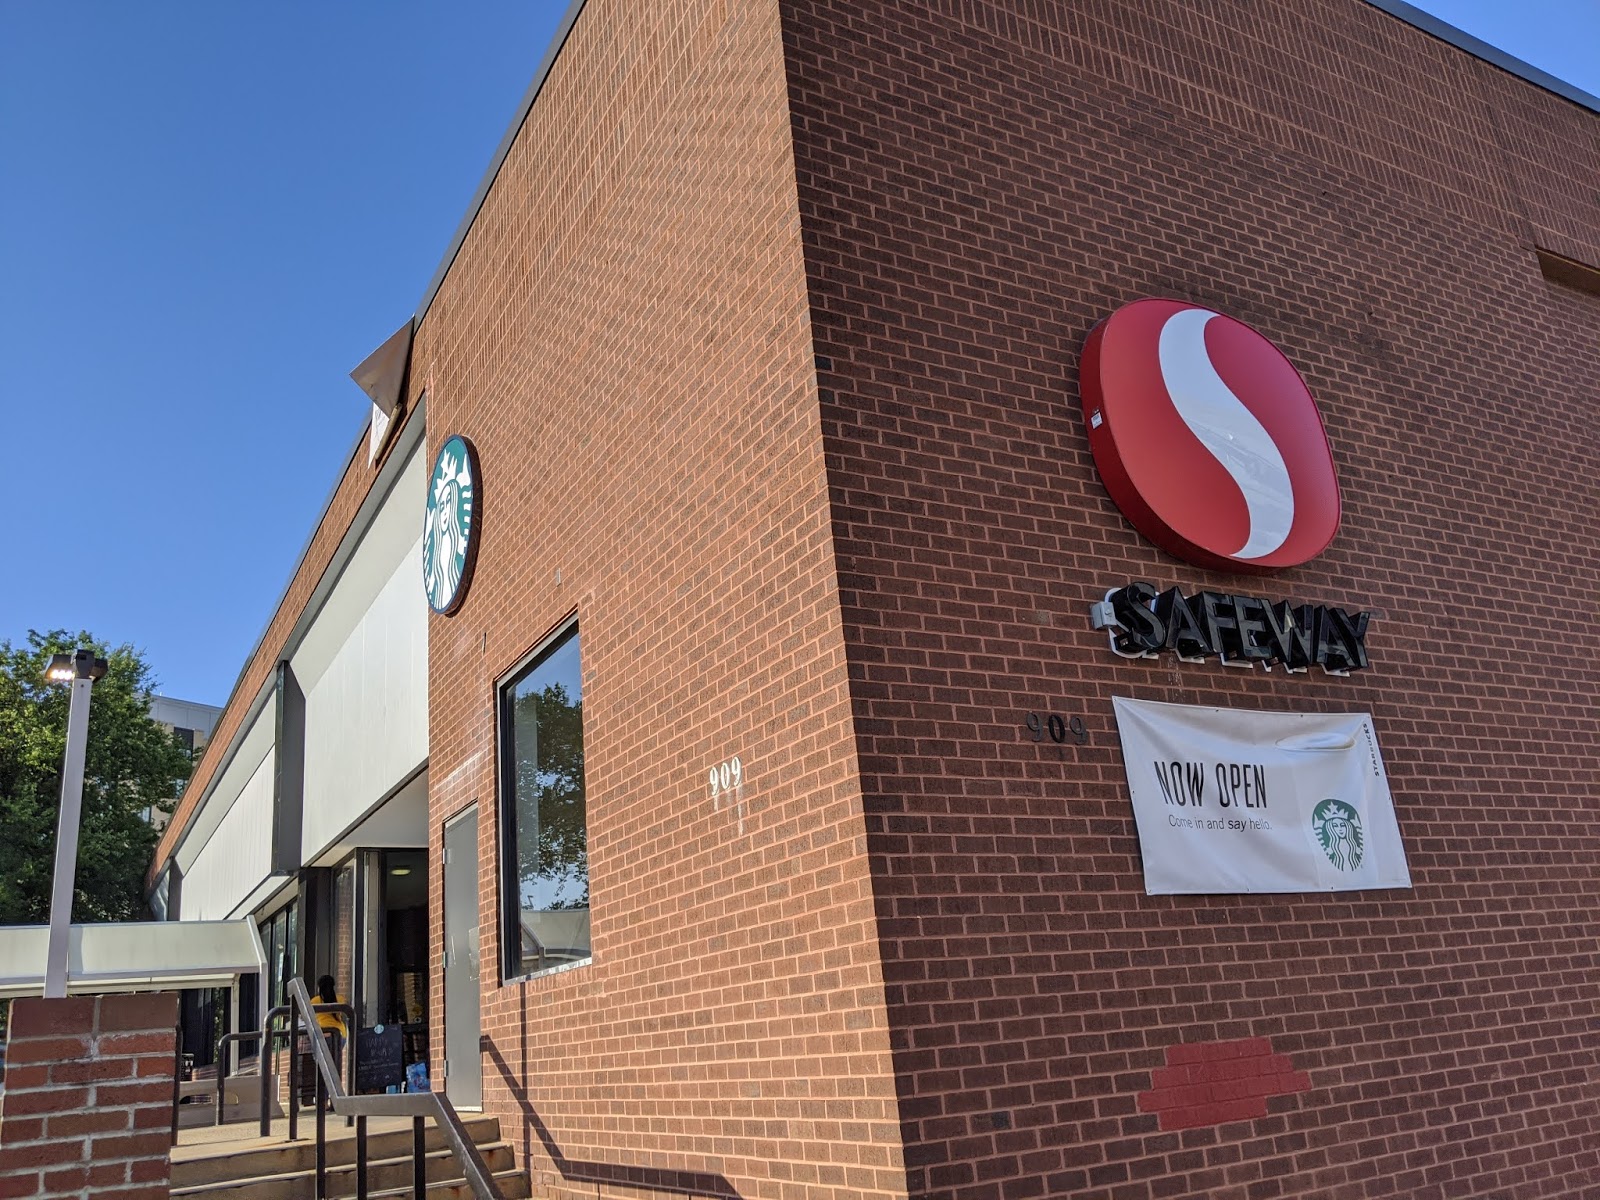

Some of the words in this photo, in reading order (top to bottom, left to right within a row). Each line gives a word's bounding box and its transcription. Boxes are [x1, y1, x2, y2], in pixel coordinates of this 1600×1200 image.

[1104, 582, 1371, 677] SAFEWAY
[1026, 712, 1088, 746] 909
[1363, 723, 1380, 777] STARBUCKS
[709, 756, 742, 796] 909
[1154, 761, 1205, 808] NOW
[1215, 763, 1268, 809] OPEN
[1168, 814, 1194, 830] Come
[1194, 816, 1204, 830] in
[1207, 817, 1225, 830] and
[1227, 819, 1247, 833] say
[1248, 817, 1273, 831] hello.
